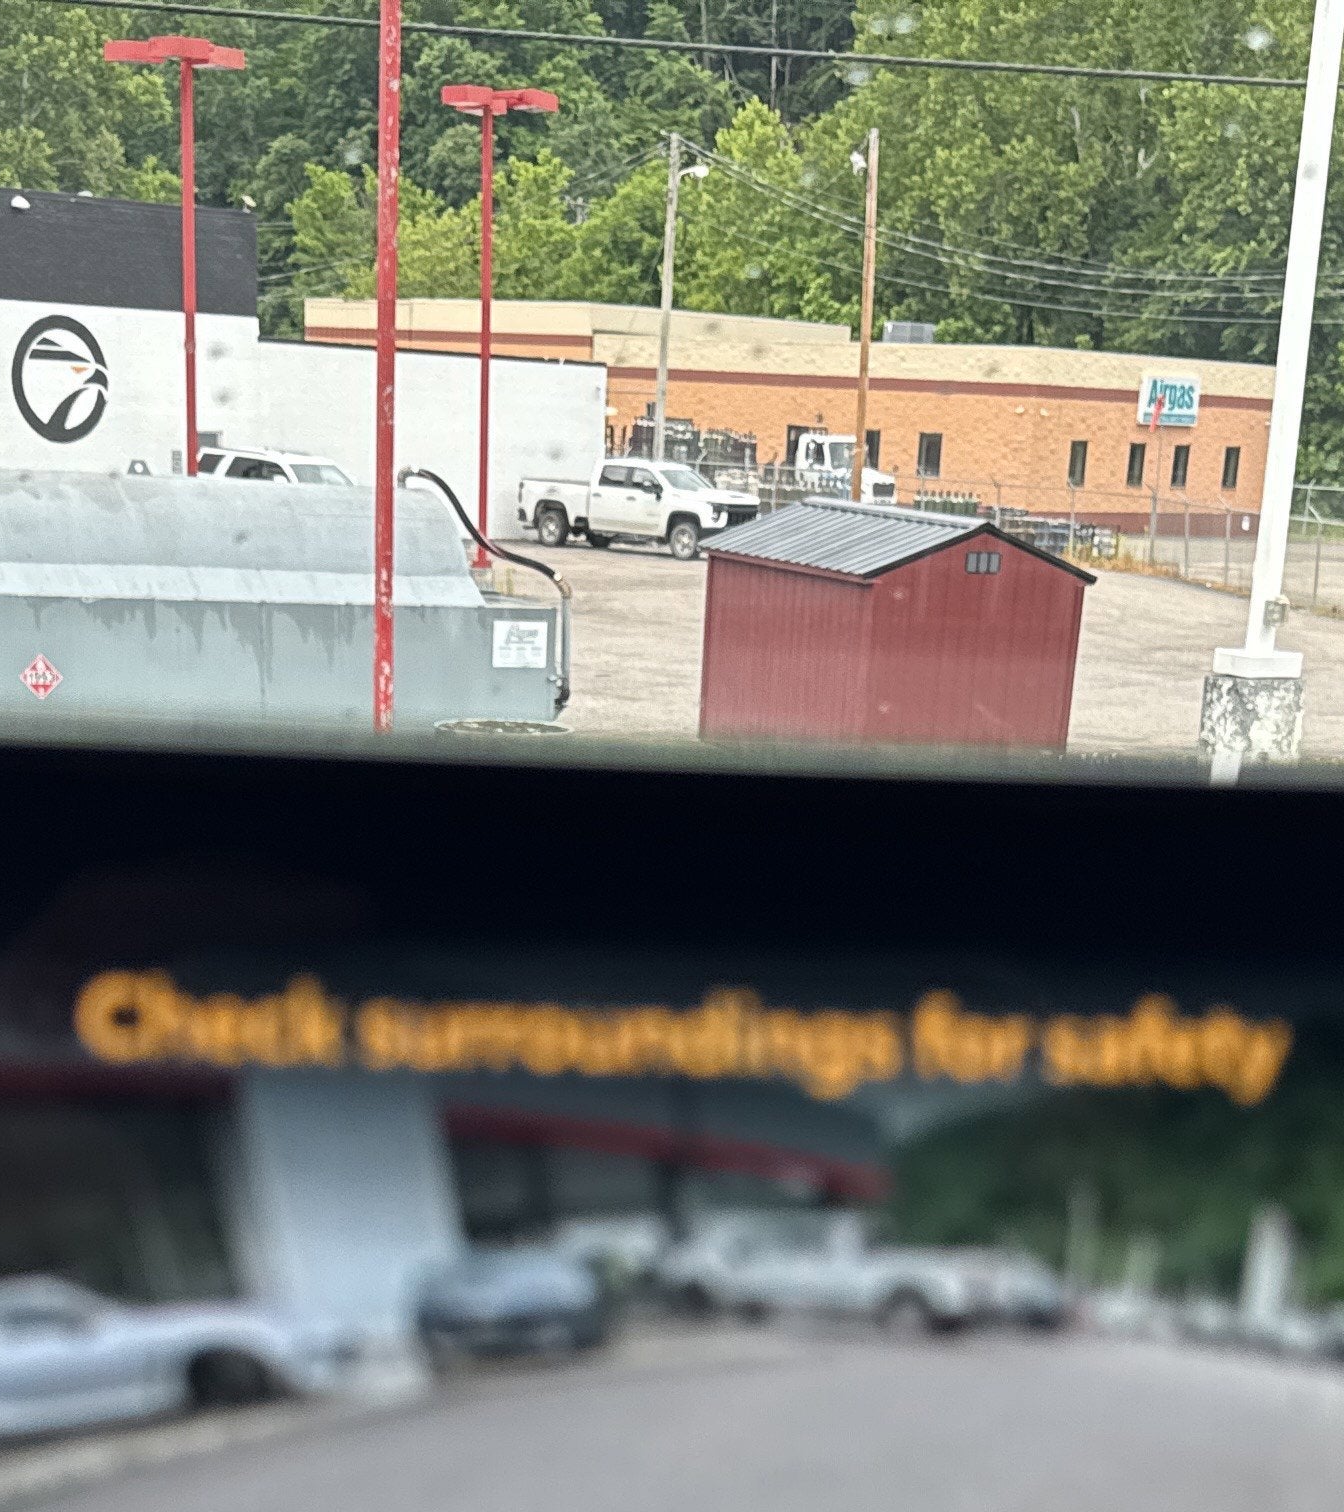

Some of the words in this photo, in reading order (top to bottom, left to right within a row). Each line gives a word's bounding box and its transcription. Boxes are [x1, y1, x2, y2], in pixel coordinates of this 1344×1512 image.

[1147, 379, 1195, 411] Airgas
[74, 968, 346, 1070] Check
[355, 985, 903, 1098] surroundings
[912, 989, 1029, 1083] for
[1041, 993, 1293, 1105] safety
